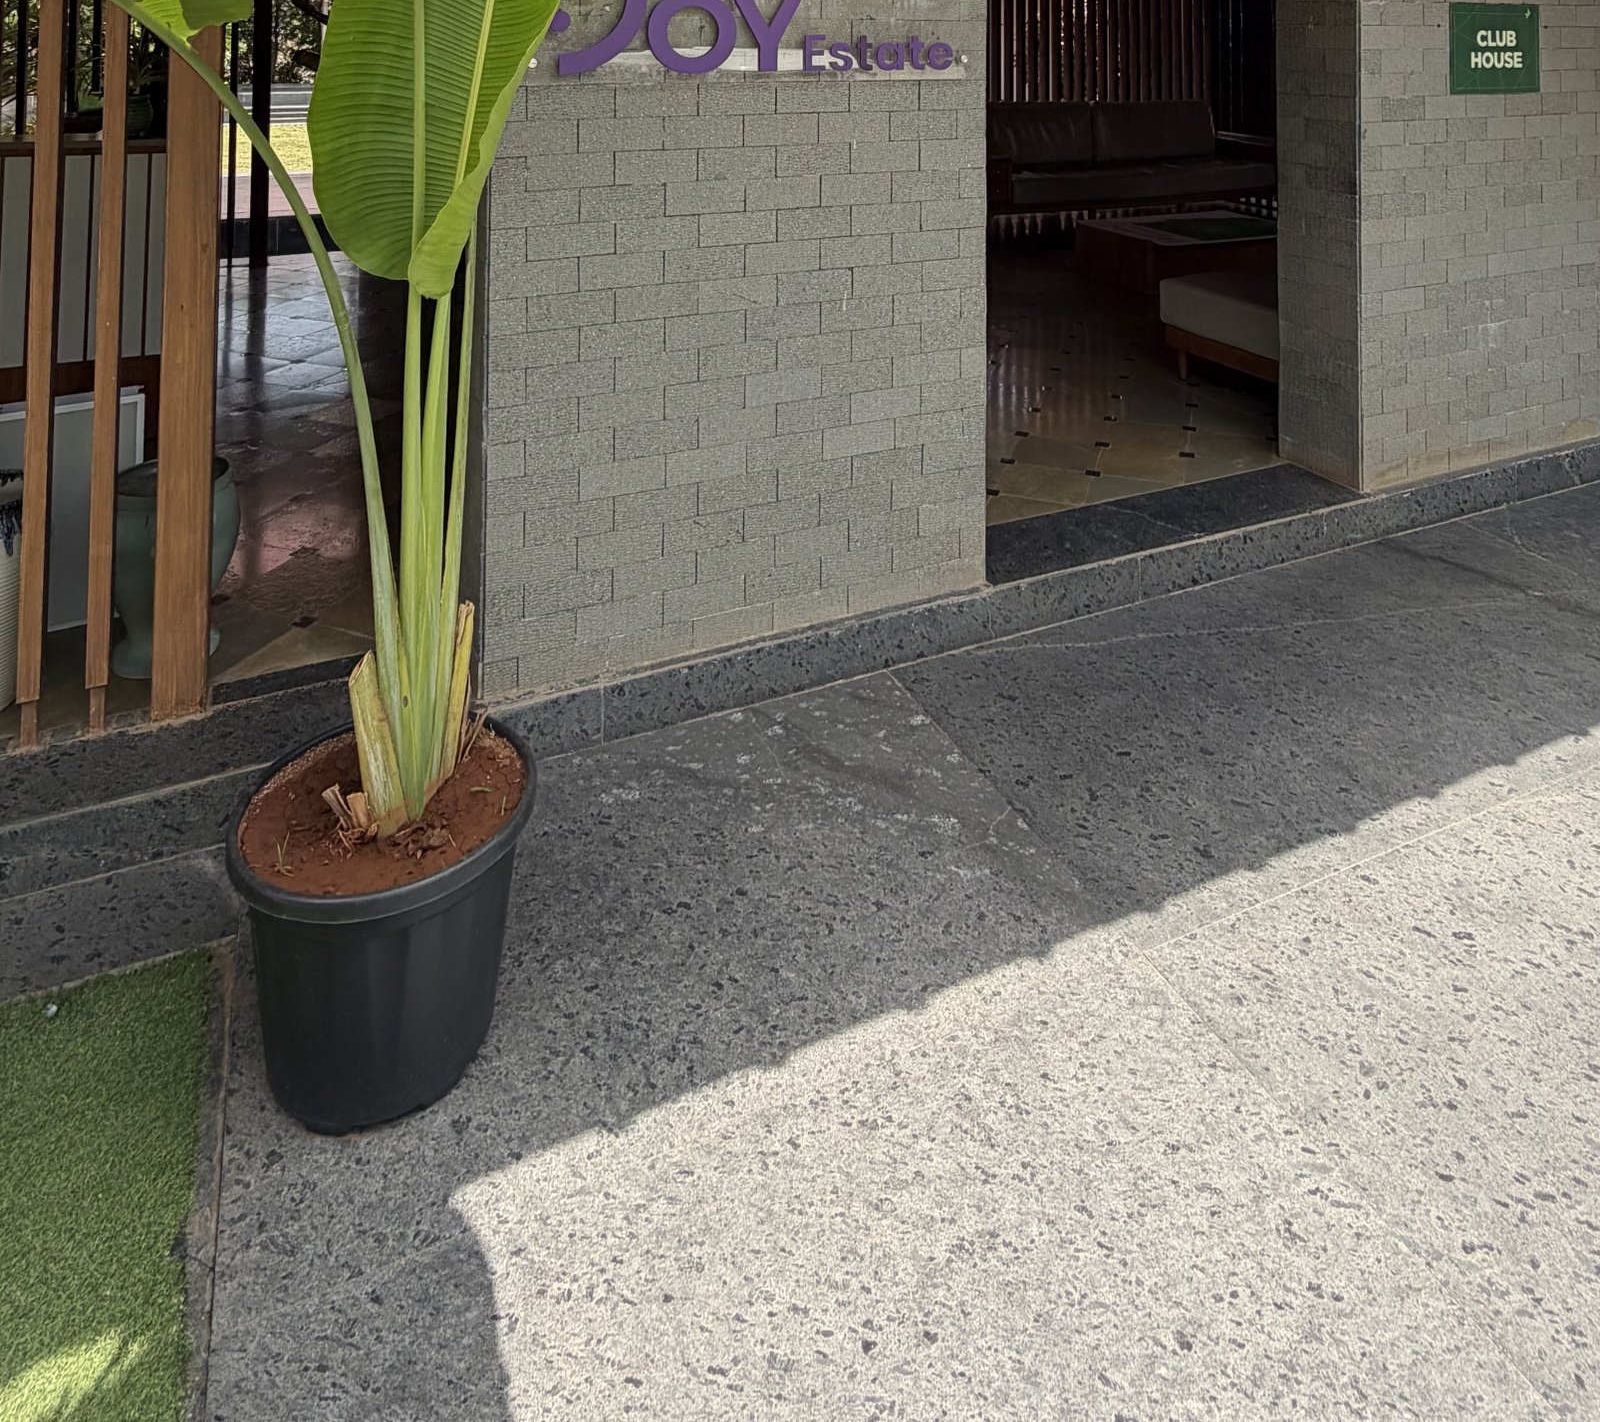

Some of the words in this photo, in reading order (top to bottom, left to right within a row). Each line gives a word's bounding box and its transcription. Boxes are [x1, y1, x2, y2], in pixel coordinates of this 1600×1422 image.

[1476, 29, 1517, 47] CLUB
[802, 33, 955, 73] Estate
[1470, 51, 1523, 69] HOUSE
